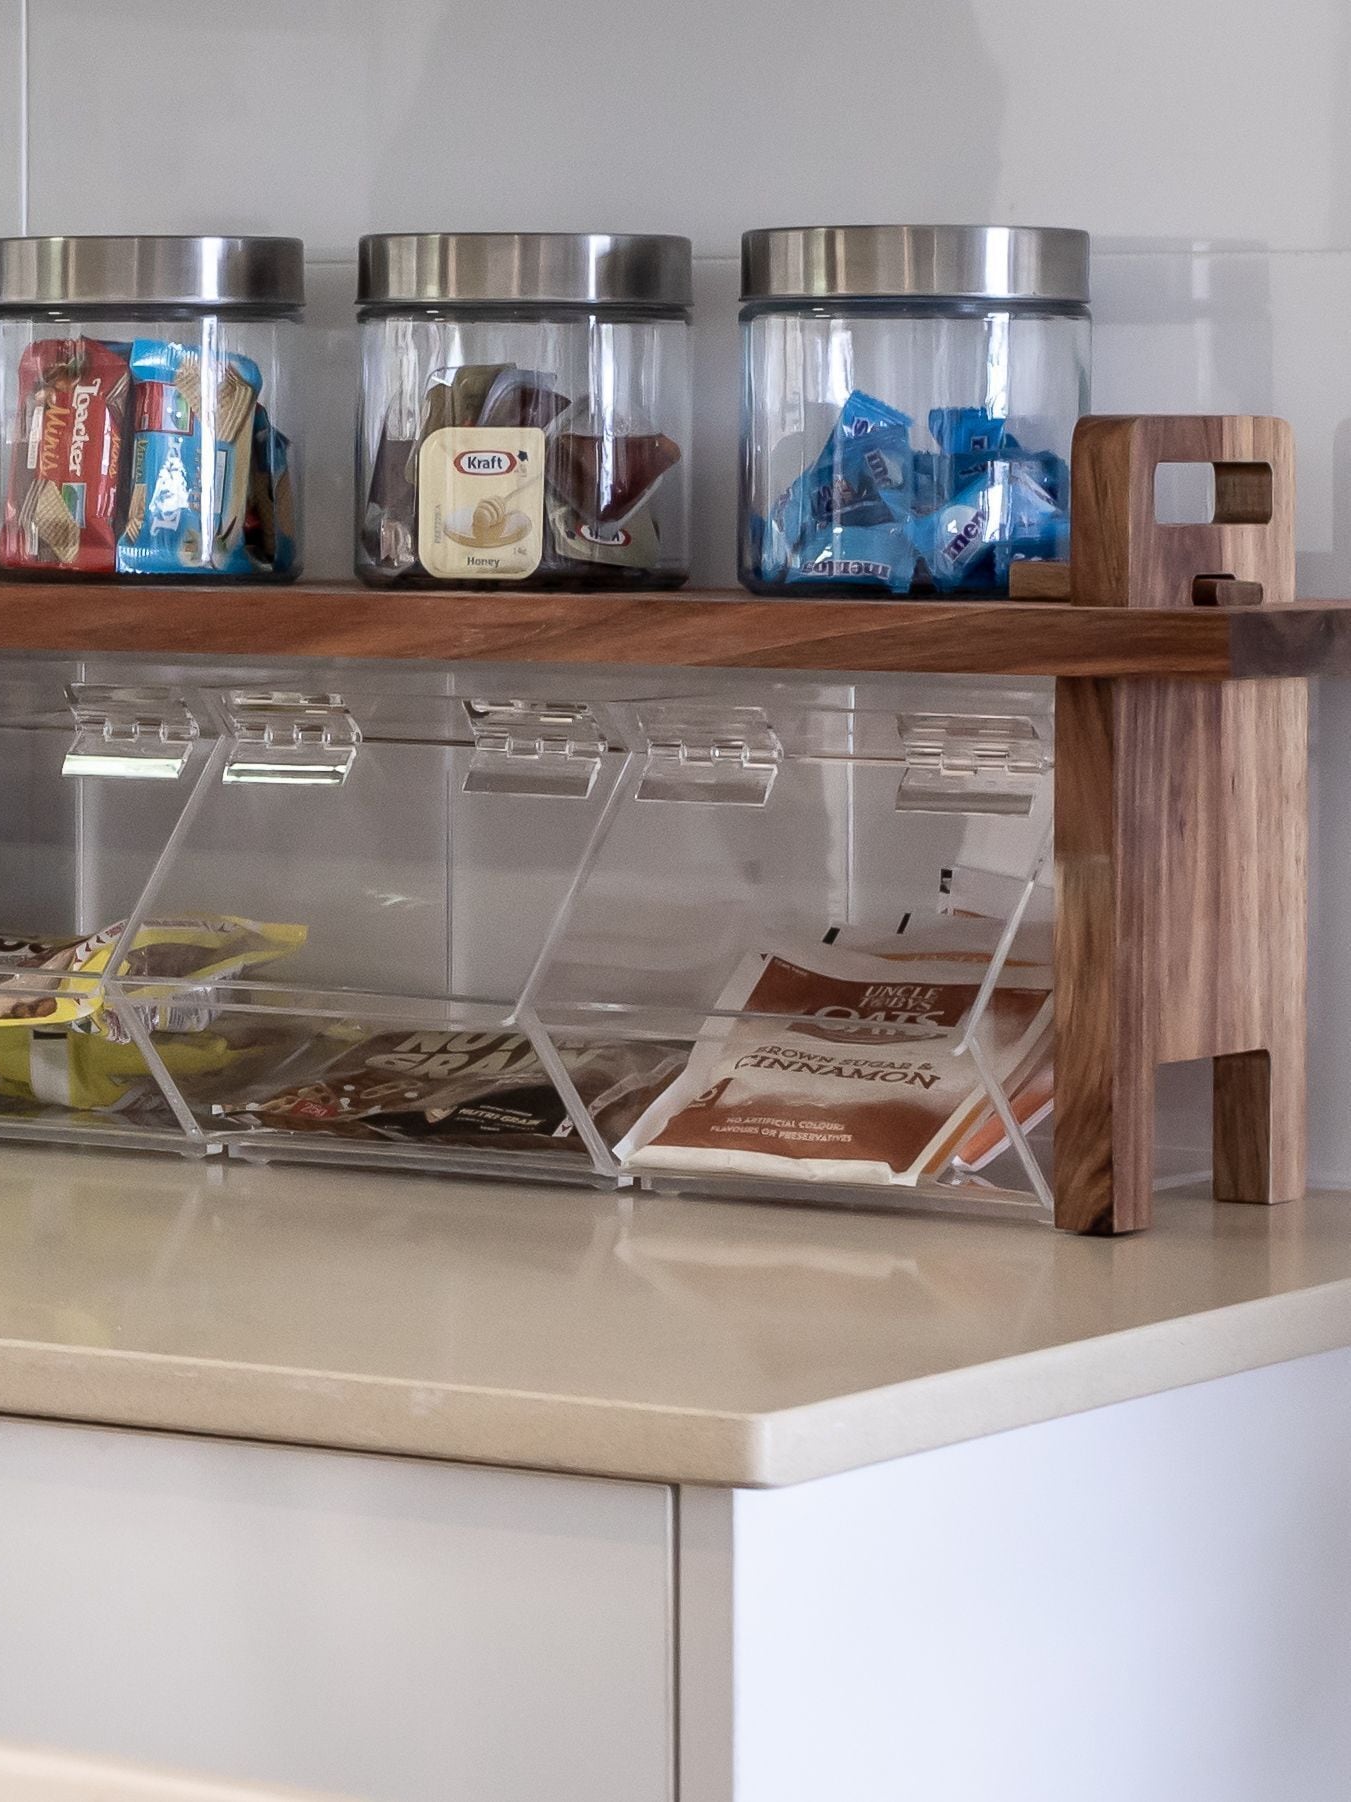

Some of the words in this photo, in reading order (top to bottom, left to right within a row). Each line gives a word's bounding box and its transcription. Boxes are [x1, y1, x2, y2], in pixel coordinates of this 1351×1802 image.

[467, 456, 503, 470] Kraft
[467, 556, 500, 568] Honey
[865, 986, 943, 999] UNCLE
[752, 1046, 835, 1063] BROWN
[838, 1059, 912, 1070] SUGAR
[917, 1062, 934, 1070] &
[735, 1054, 941, 1090] CINNAMON
[743, 1118, 796, 1128] ARTIFICIAL
[761, 1128, 777, 1137] OR
[778, 1131, 853, 1142] PRESERVATIVES
